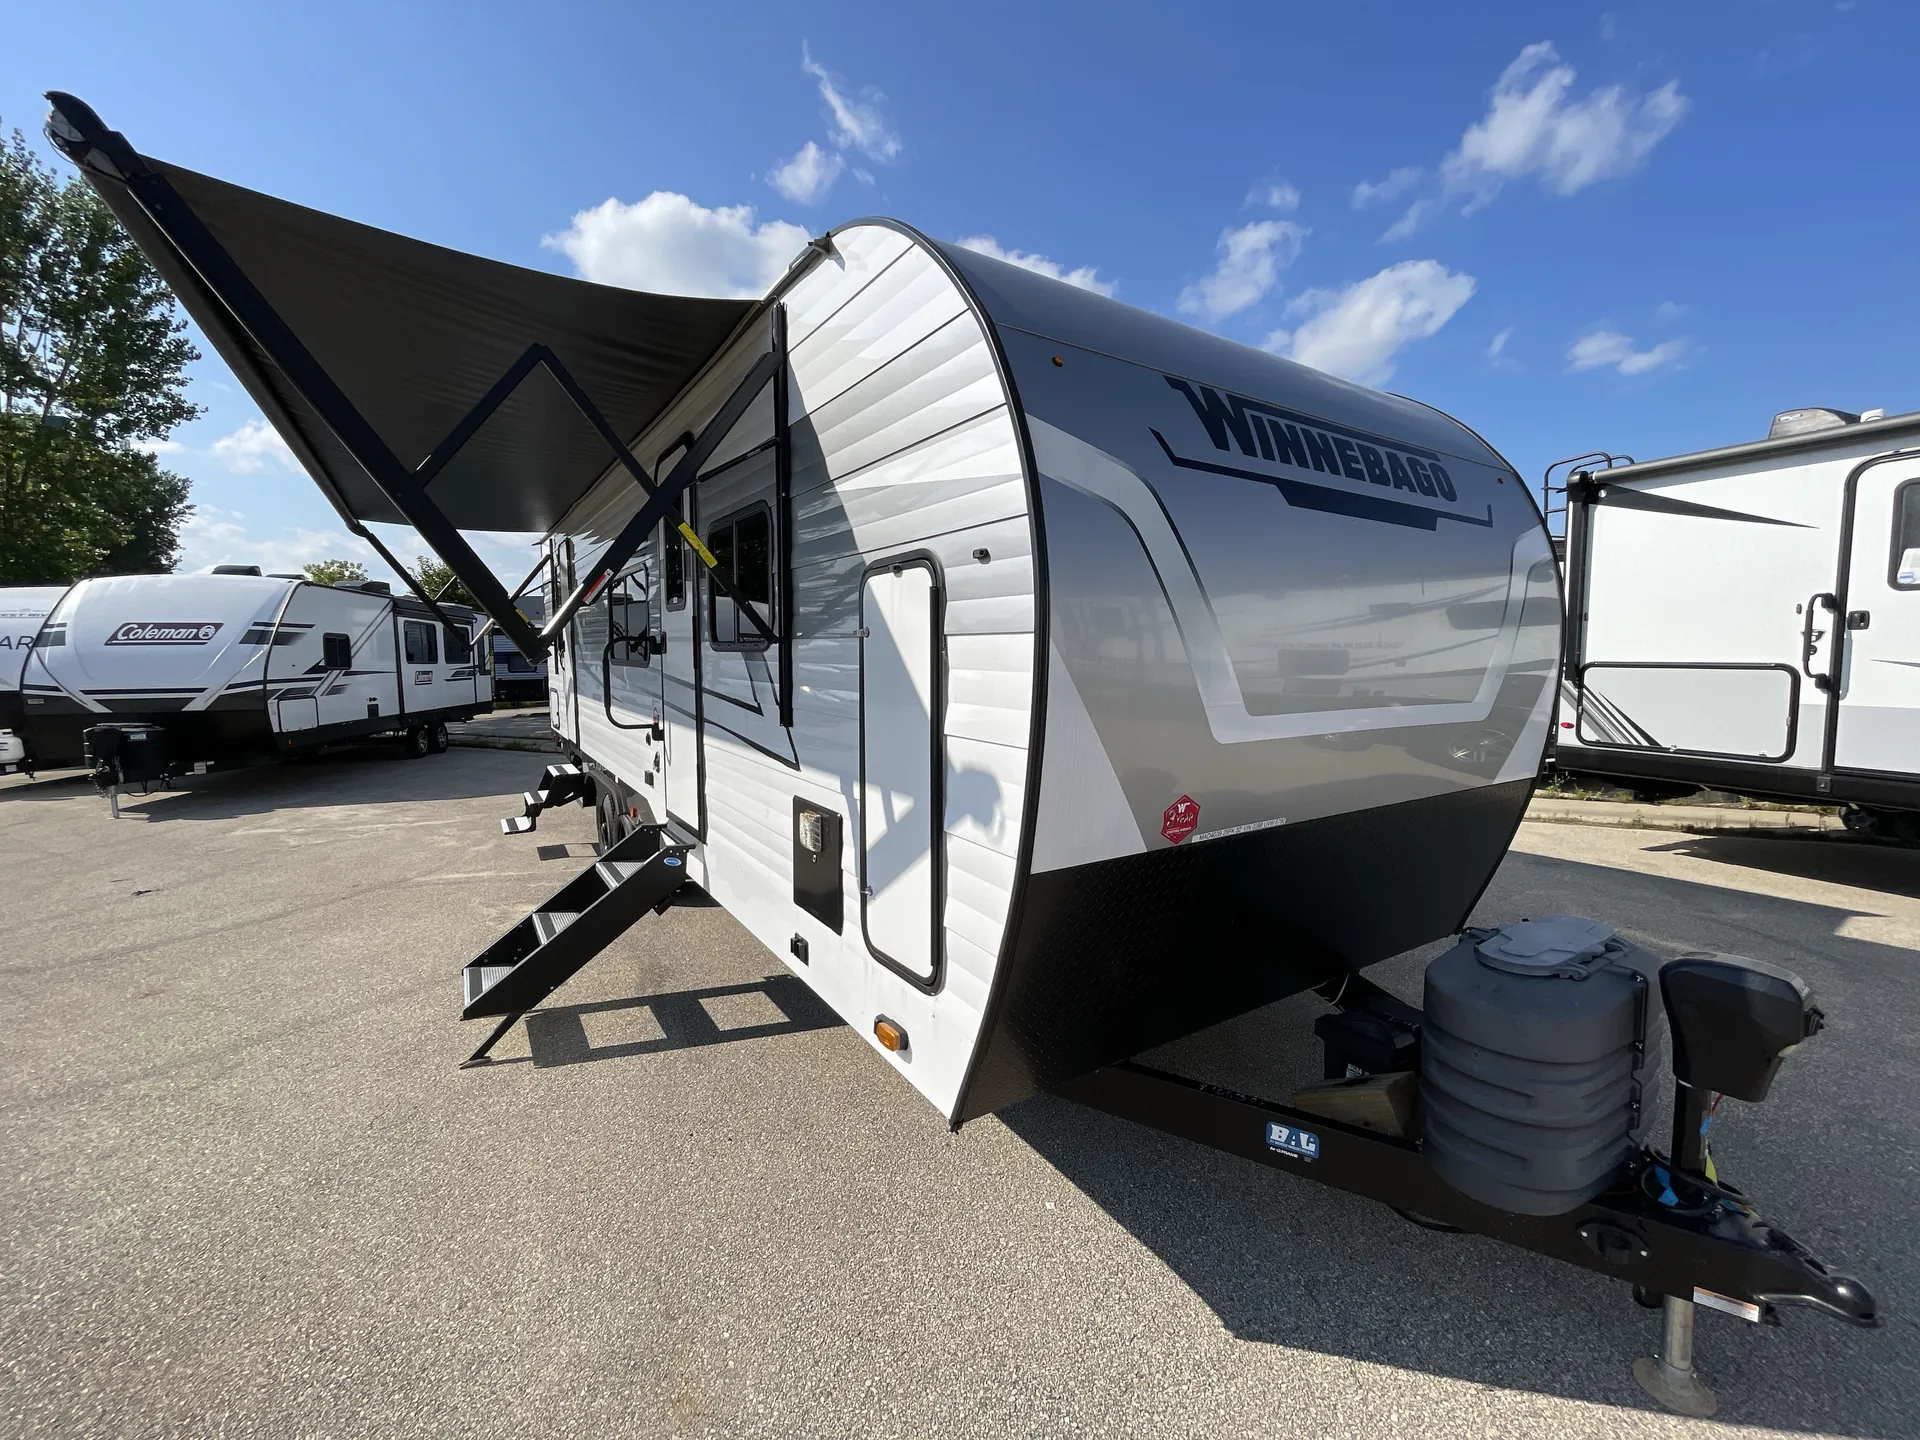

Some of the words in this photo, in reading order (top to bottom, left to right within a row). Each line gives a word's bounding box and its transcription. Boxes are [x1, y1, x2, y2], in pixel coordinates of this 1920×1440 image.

[1163, 374, 1458, 502] WINNEBAGO
[117, 624, 196, 640] Coleman
[1270, 1124, 1316, 1152] BAL
